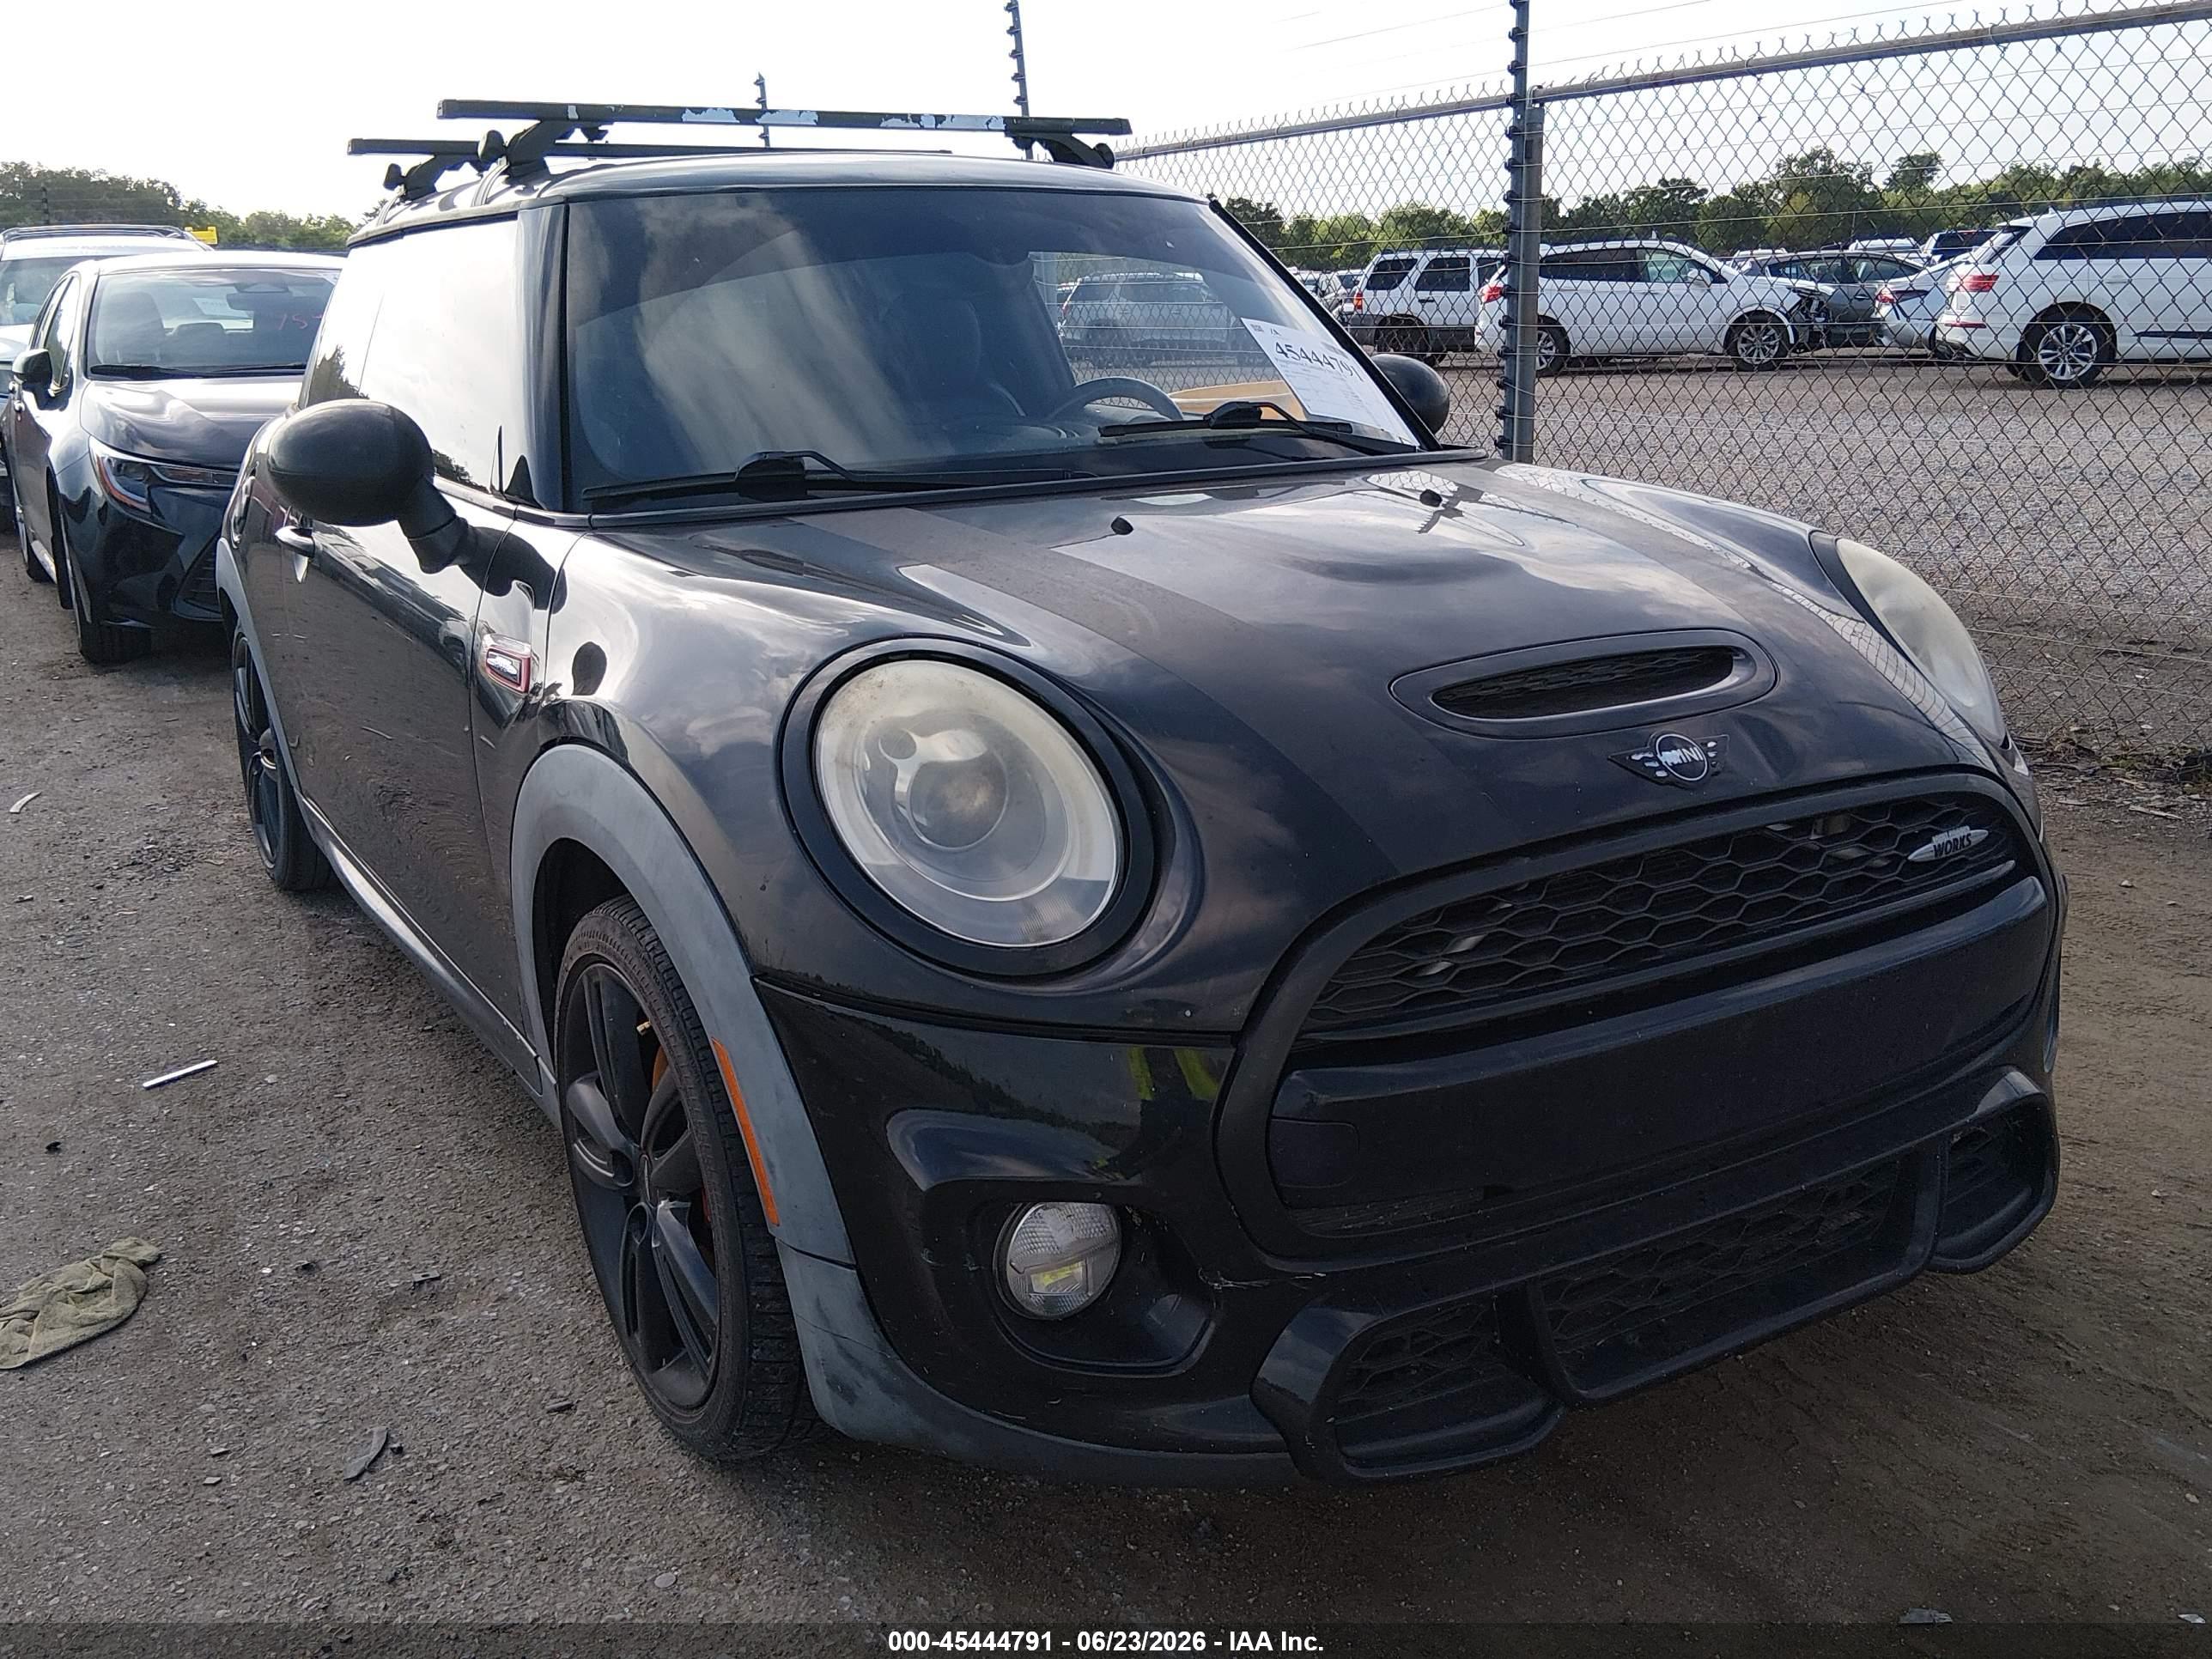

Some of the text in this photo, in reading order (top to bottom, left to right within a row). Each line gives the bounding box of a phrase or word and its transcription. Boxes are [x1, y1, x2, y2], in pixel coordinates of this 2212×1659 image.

[1274, 341, 1364, 382] 45444791
[1659, 746, 1705, 767] MINI
[1933, 833, 1972, 858] WORKS
